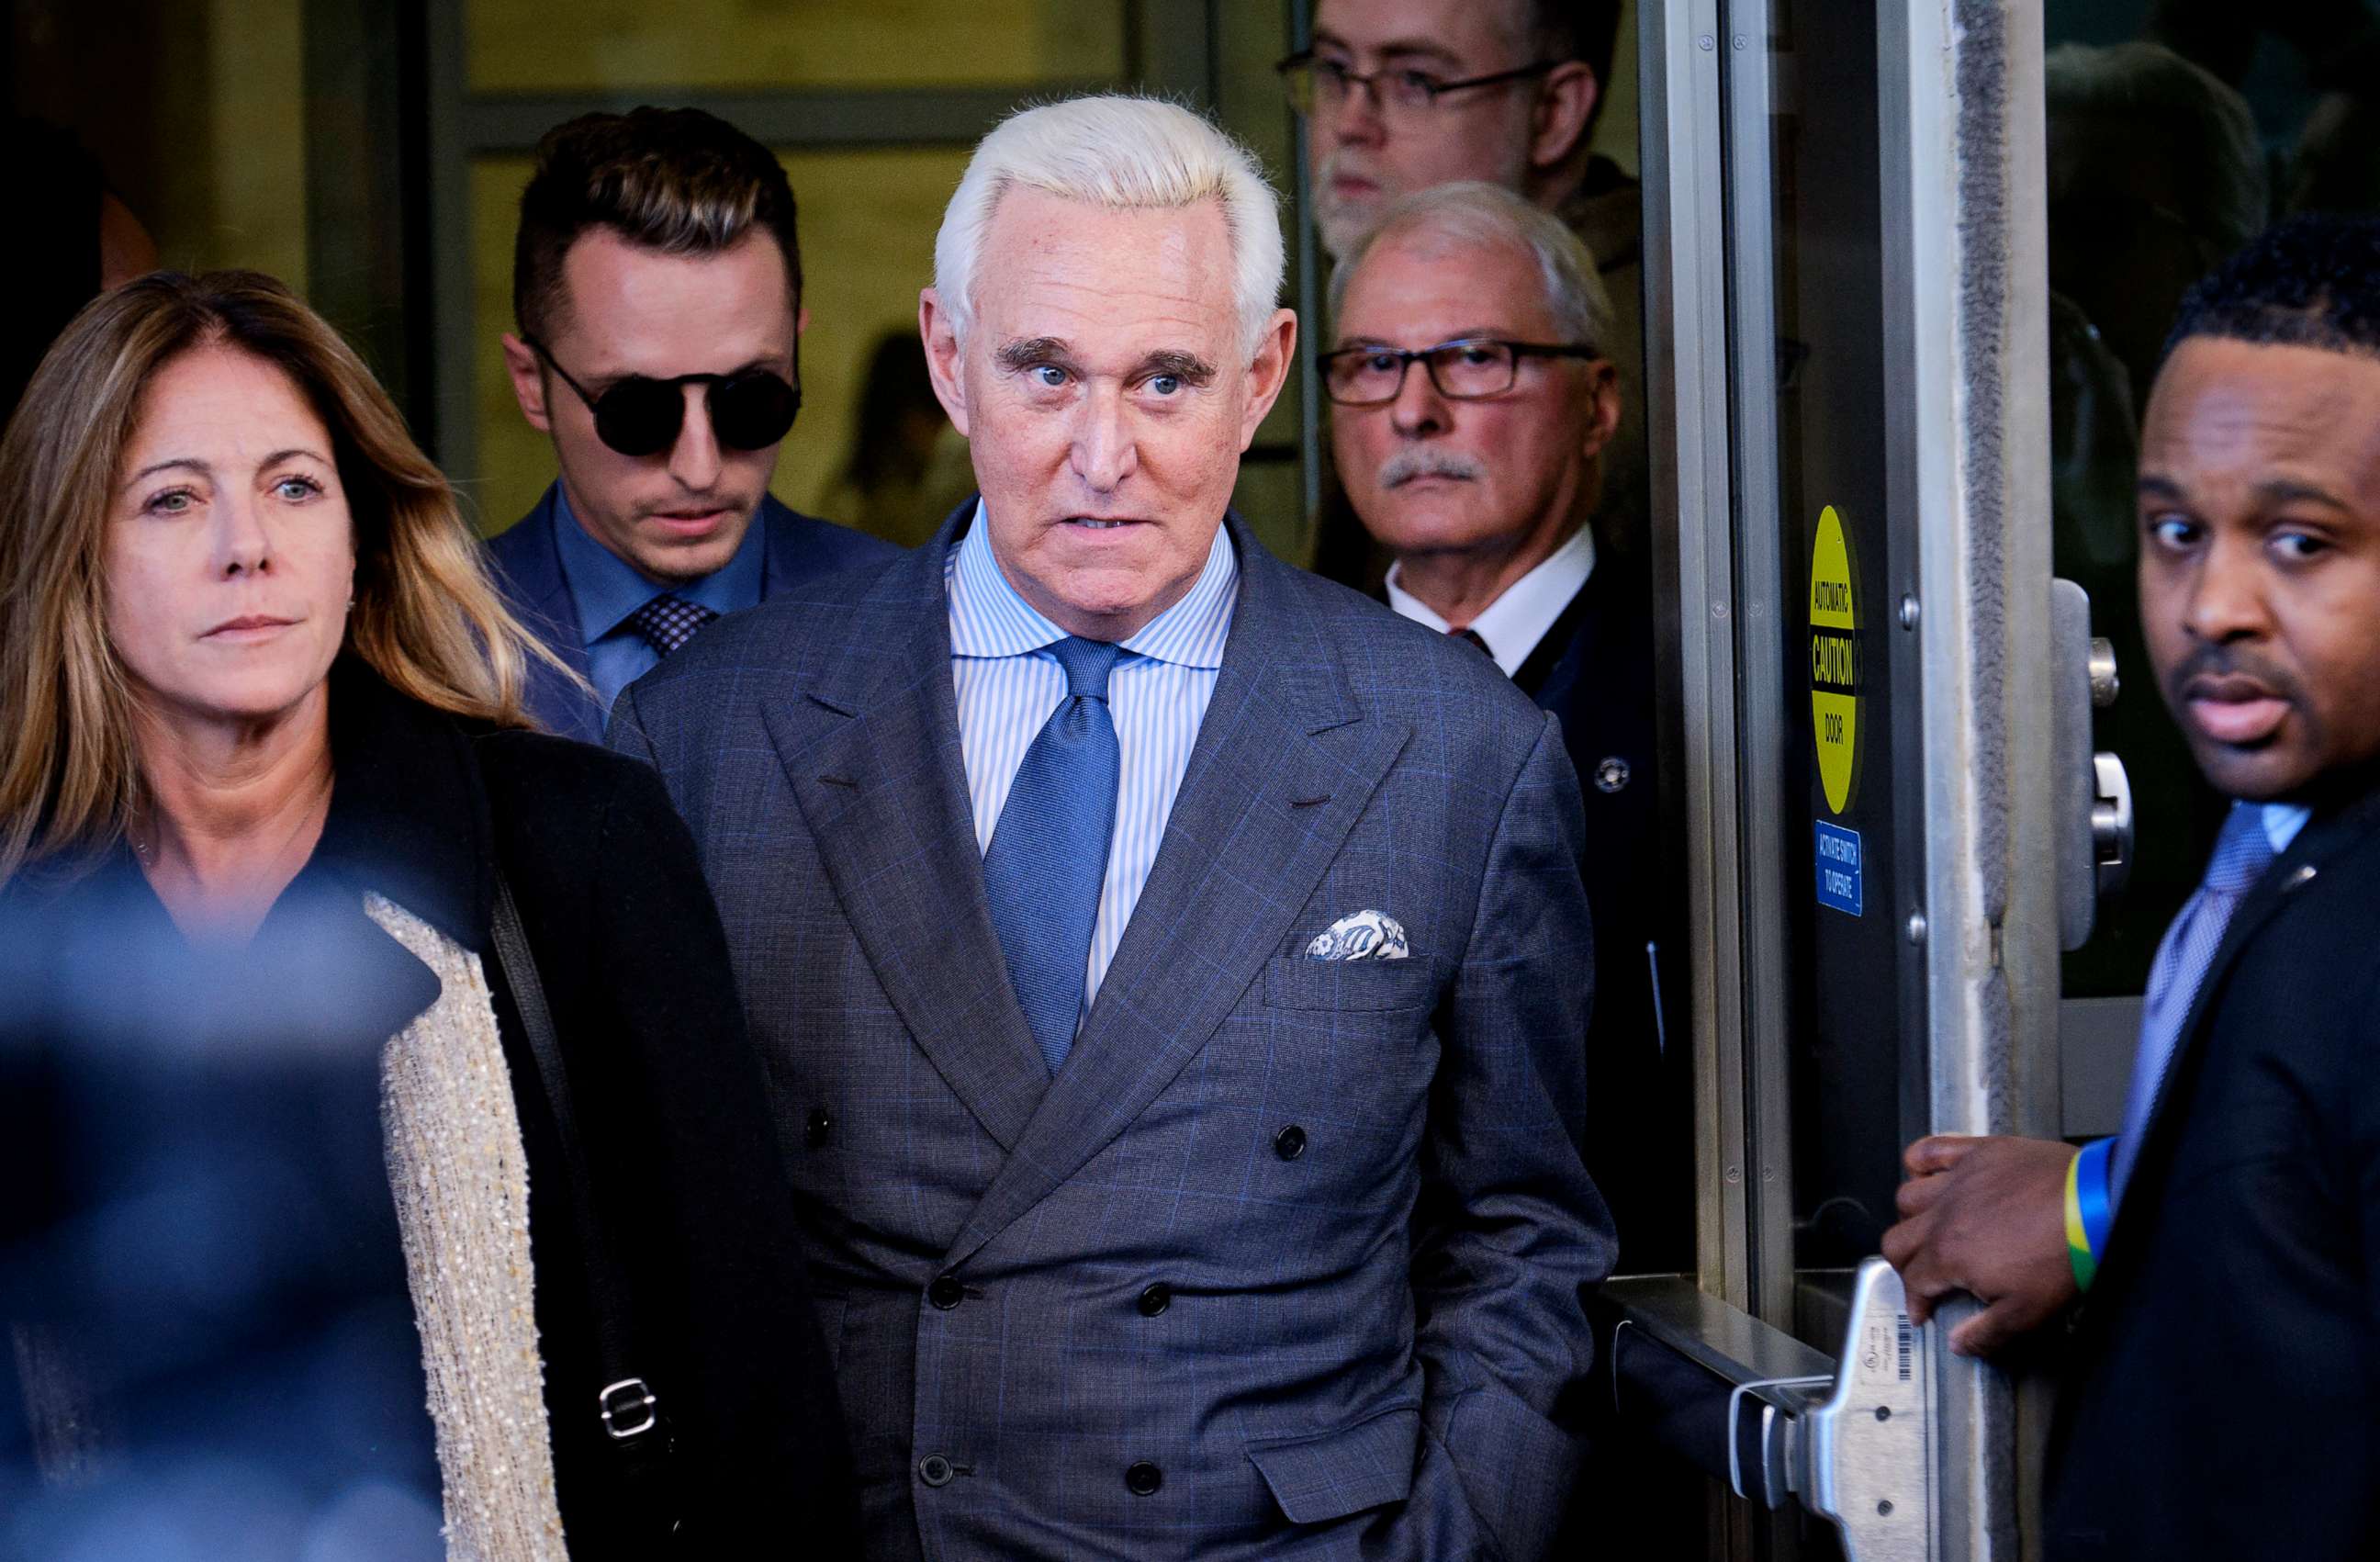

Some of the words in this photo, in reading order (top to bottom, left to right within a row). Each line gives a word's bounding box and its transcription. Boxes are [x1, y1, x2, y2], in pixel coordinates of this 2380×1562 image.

[1814, 580, 1848, 613] AUTOMATIC
[1813, 634, 1853, 685] CAUTION
[1825, 713, 1844, 745] DOOR
[1820, 833, 1840, 860] ACTIVATE
[1840, 838, 1857, 866] SWITCH
[1824, 869, 1832, 893] TO
[1832, 871, 1853, 899] OPERATE
